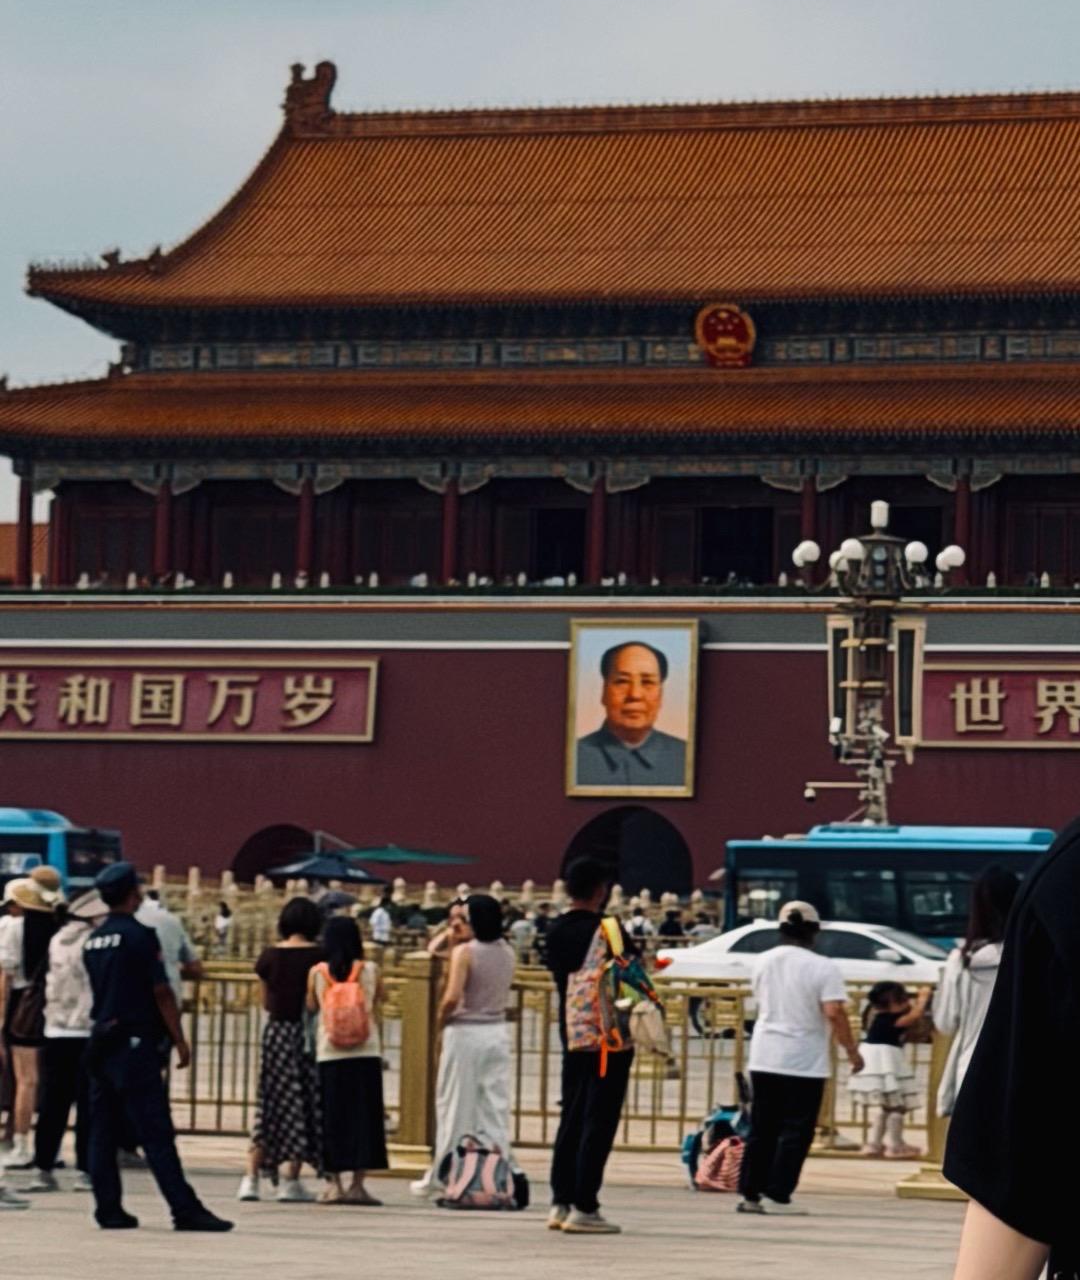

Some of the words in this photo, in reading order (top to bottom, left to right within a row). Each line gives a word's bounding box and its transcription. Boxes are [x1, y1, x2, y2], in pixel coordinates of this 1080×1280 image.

[0, 673, 335, 727] 共和国万岁
